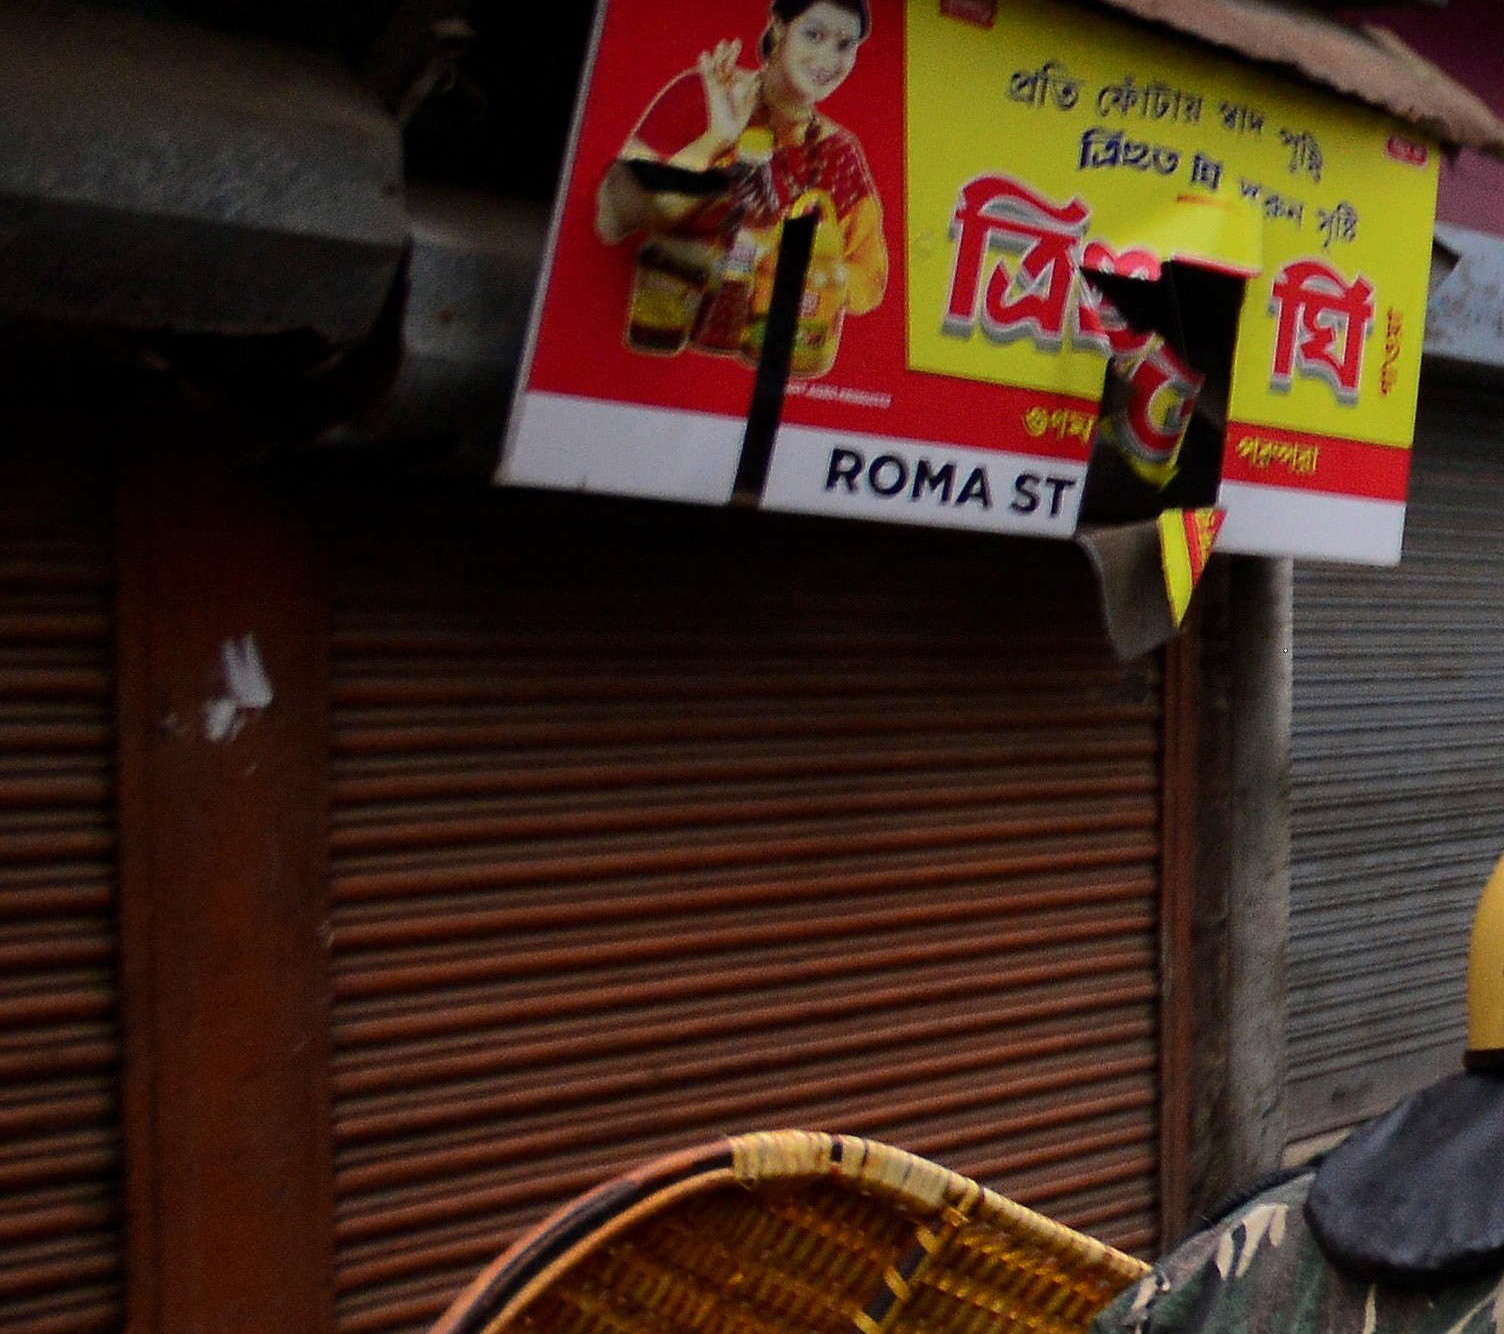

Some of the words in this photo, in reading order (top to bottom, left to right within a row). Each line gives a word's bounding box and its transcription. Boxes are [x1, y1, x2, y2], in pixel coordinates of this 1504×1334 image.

[1007, 60, 1082, 110] প্রতি
[1188, 152, 1223, 191] ঘি
[1268, 258, 1378, 405] ঘি
[825, 447, 994, 510] ROMA
[1008, 472, 1078, 516] ST
